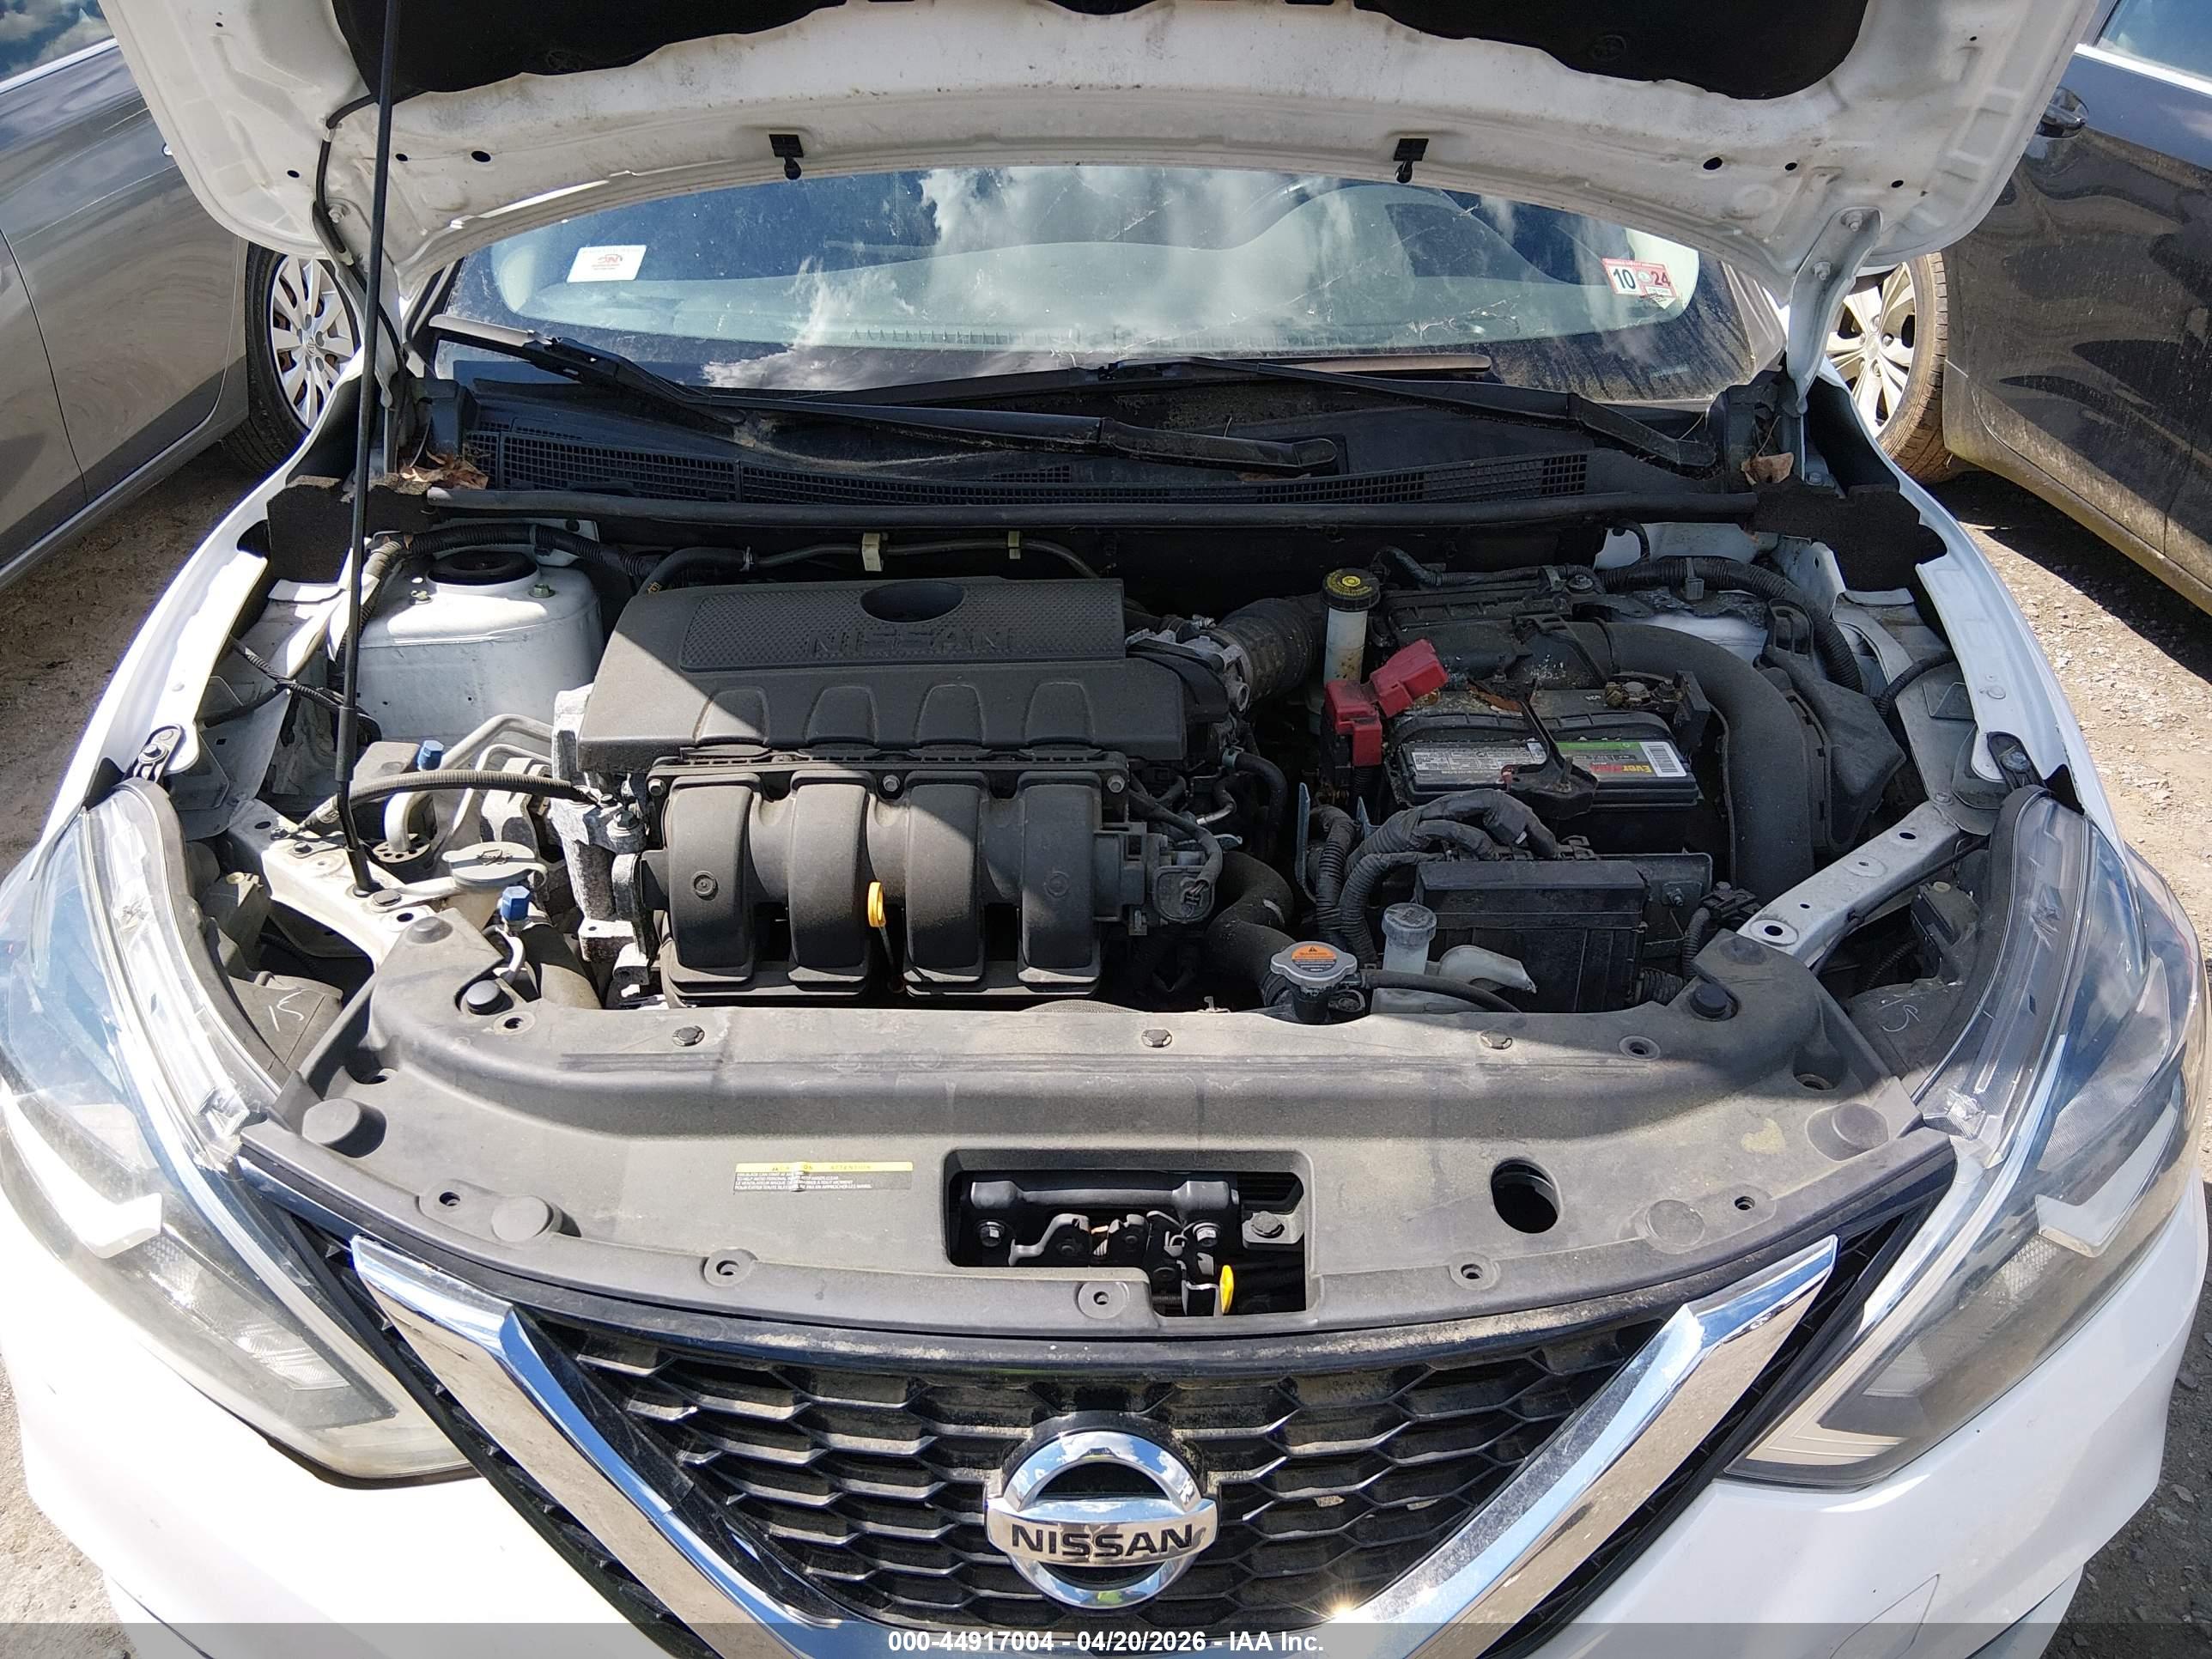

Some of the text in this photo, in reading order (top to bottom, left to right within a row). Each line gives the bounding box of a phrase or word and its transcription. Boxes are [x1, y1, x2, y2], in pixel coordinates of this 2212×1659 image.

[1613, 268, 1671, 289] 10 24
[806, 630, 1011, 654] NISSAN
[1011, 1523, 1193, 1558] NISSAN
